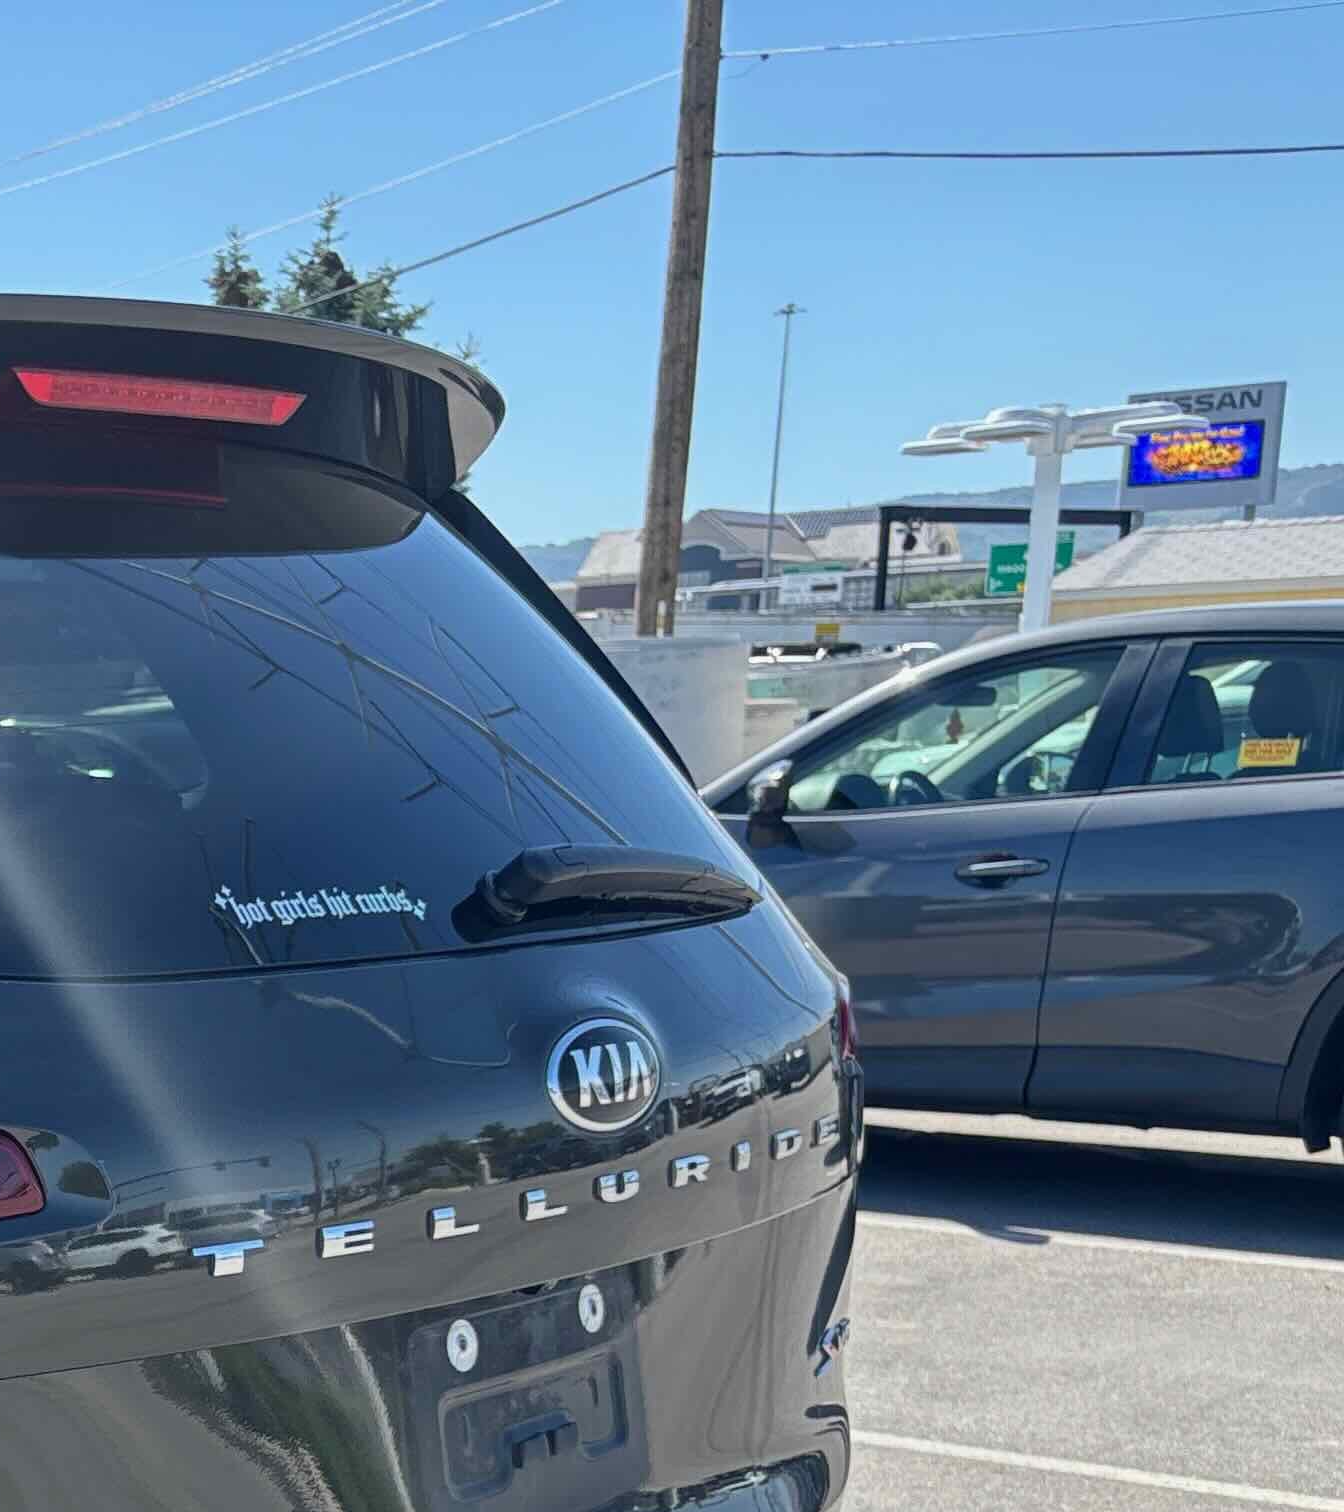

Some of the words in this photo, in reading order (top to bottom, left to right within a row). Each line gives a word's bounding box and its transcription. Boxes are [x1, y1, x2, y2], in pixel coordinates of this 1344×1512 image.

[227, 896, 273, 929] hot
[270, 890, 327, 926] girls
[318, 887, 358, 919] hit
[355, 885, 413, 914] curbs
[569, 1040, 654, 1108] KIA
[191, 1111, 842, 1277] TELLURIDE
